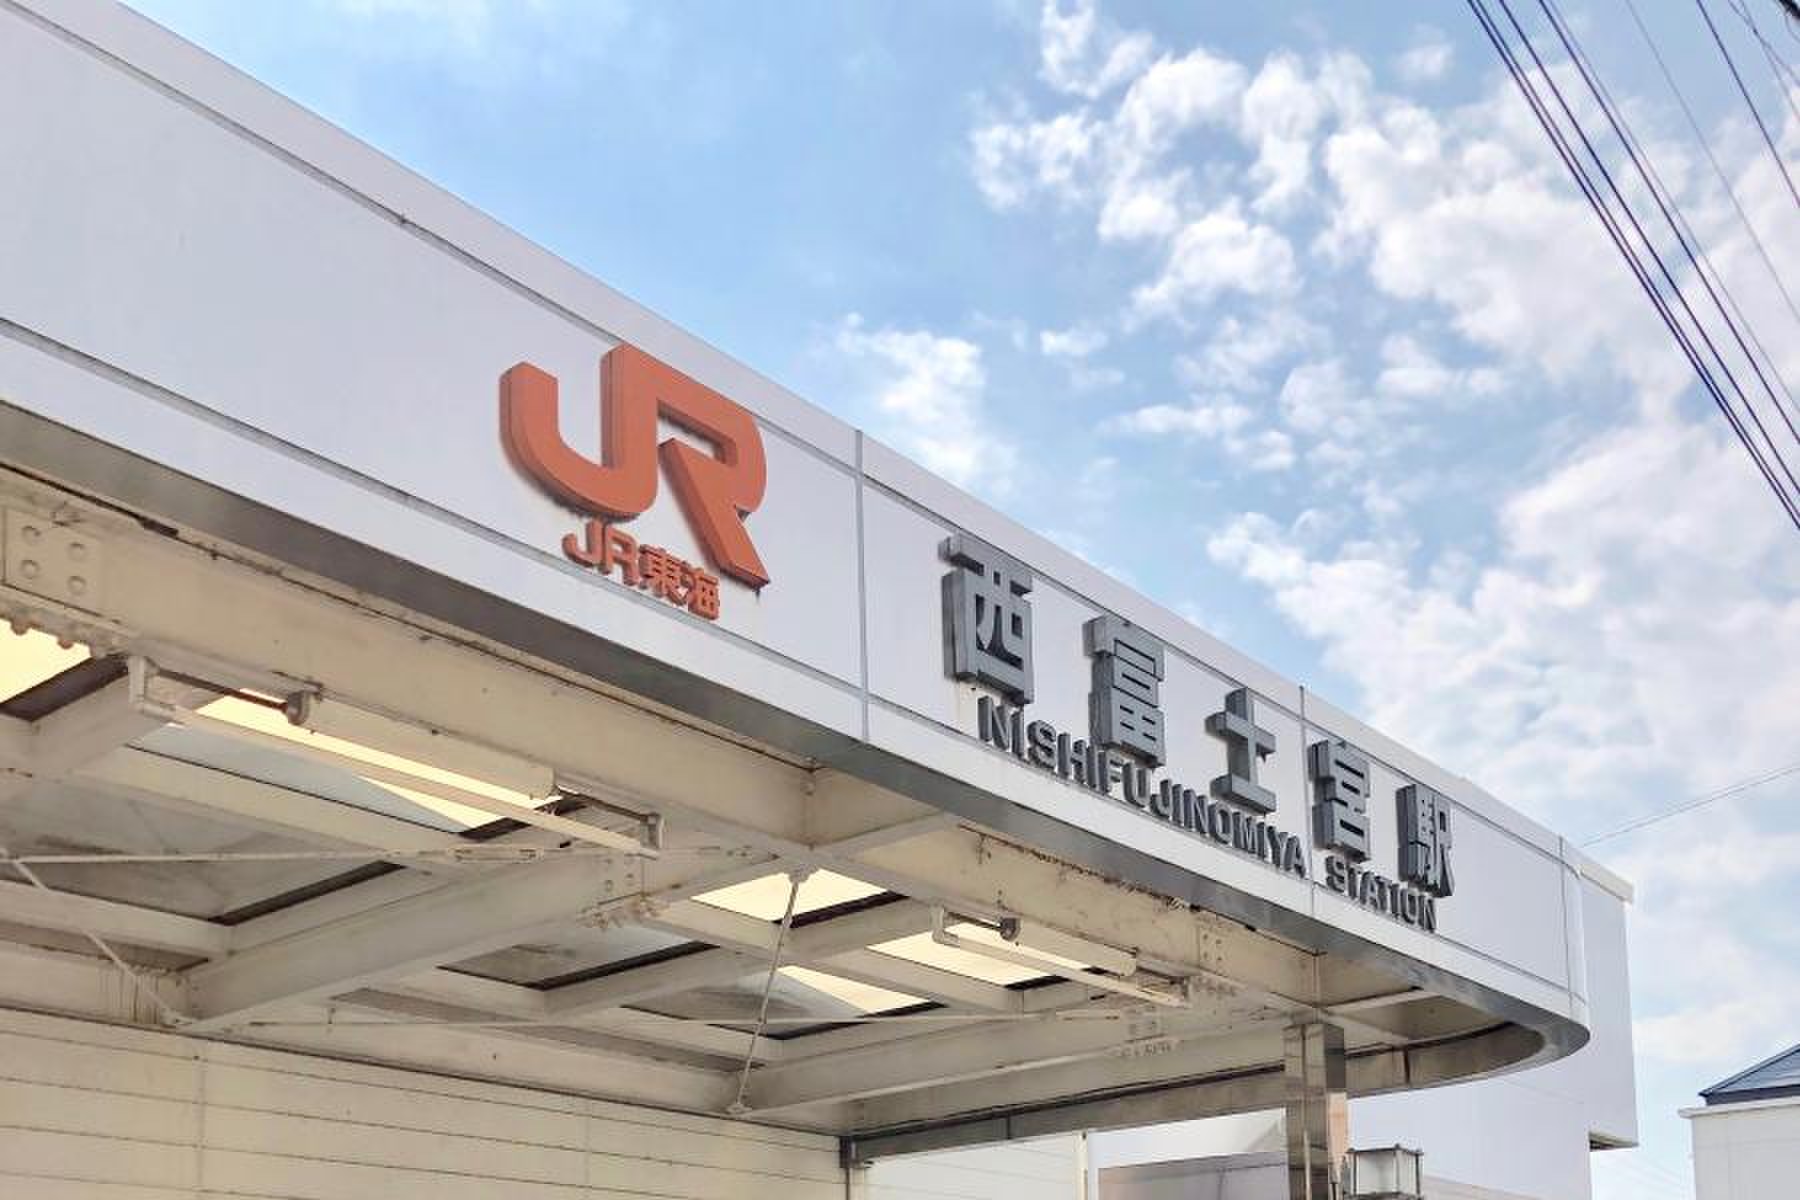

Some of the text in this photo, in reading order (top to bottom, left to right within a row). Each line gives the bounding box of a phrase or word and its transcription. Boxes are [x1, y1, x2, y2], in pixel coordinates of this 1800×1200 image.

[499, 343, 769, 589] JR
[562, 518, 720, 620] JR東海
[938, 533, 1455, 898] 西富士宮駅
[977, 696, 1436, 933] NISHIFUJINOMIYA STATION
